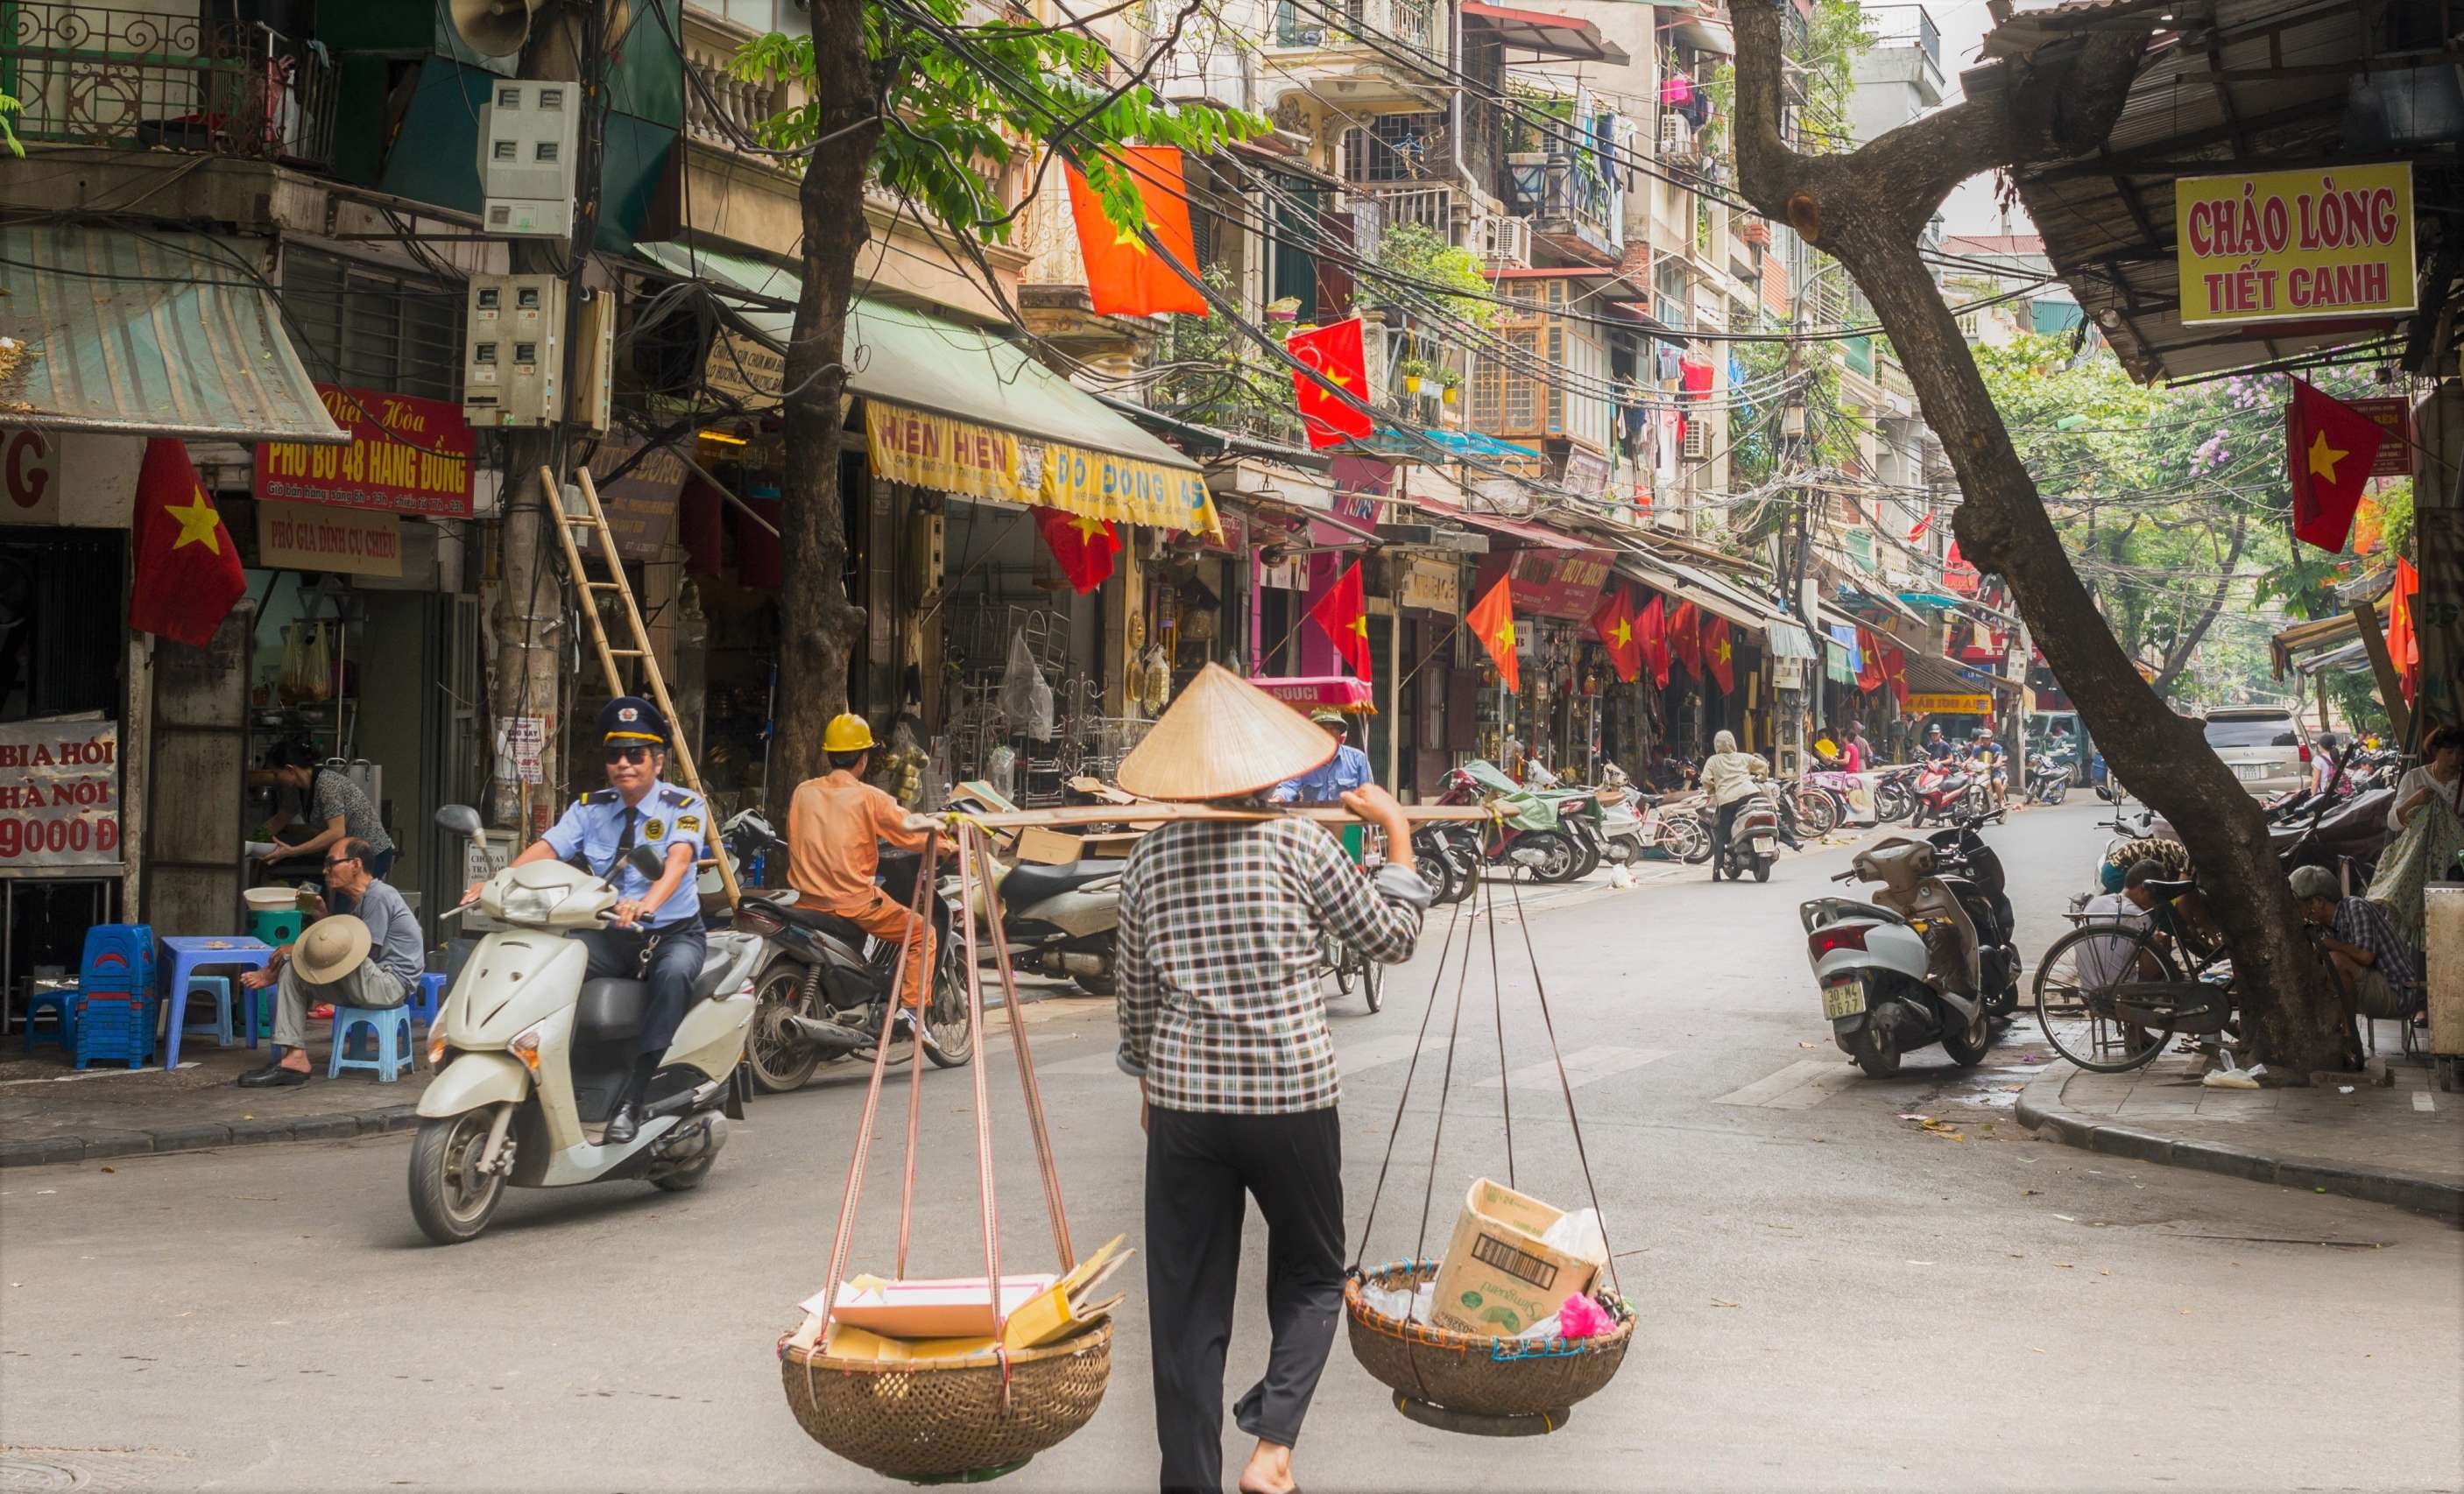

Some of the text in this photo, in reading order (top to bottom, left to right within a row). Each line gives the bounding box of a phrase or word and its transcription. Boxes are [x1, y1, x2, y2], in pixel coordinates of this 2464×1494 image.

[2188, 175, 2399, 258] CHÁO LÒNG
[2203, 258, 2389, 314] TIẾT CANH
[369, 433, 416, 490] HÀNG
[420, 435, 466, 494] ĐỒNG
[1273, 687, 1317, 701] SOUCI
[51, 775, 109, 814] NỘI
[0, 818, 88, 858] 9000
[1829, 998, 1858, 1017] 0627
